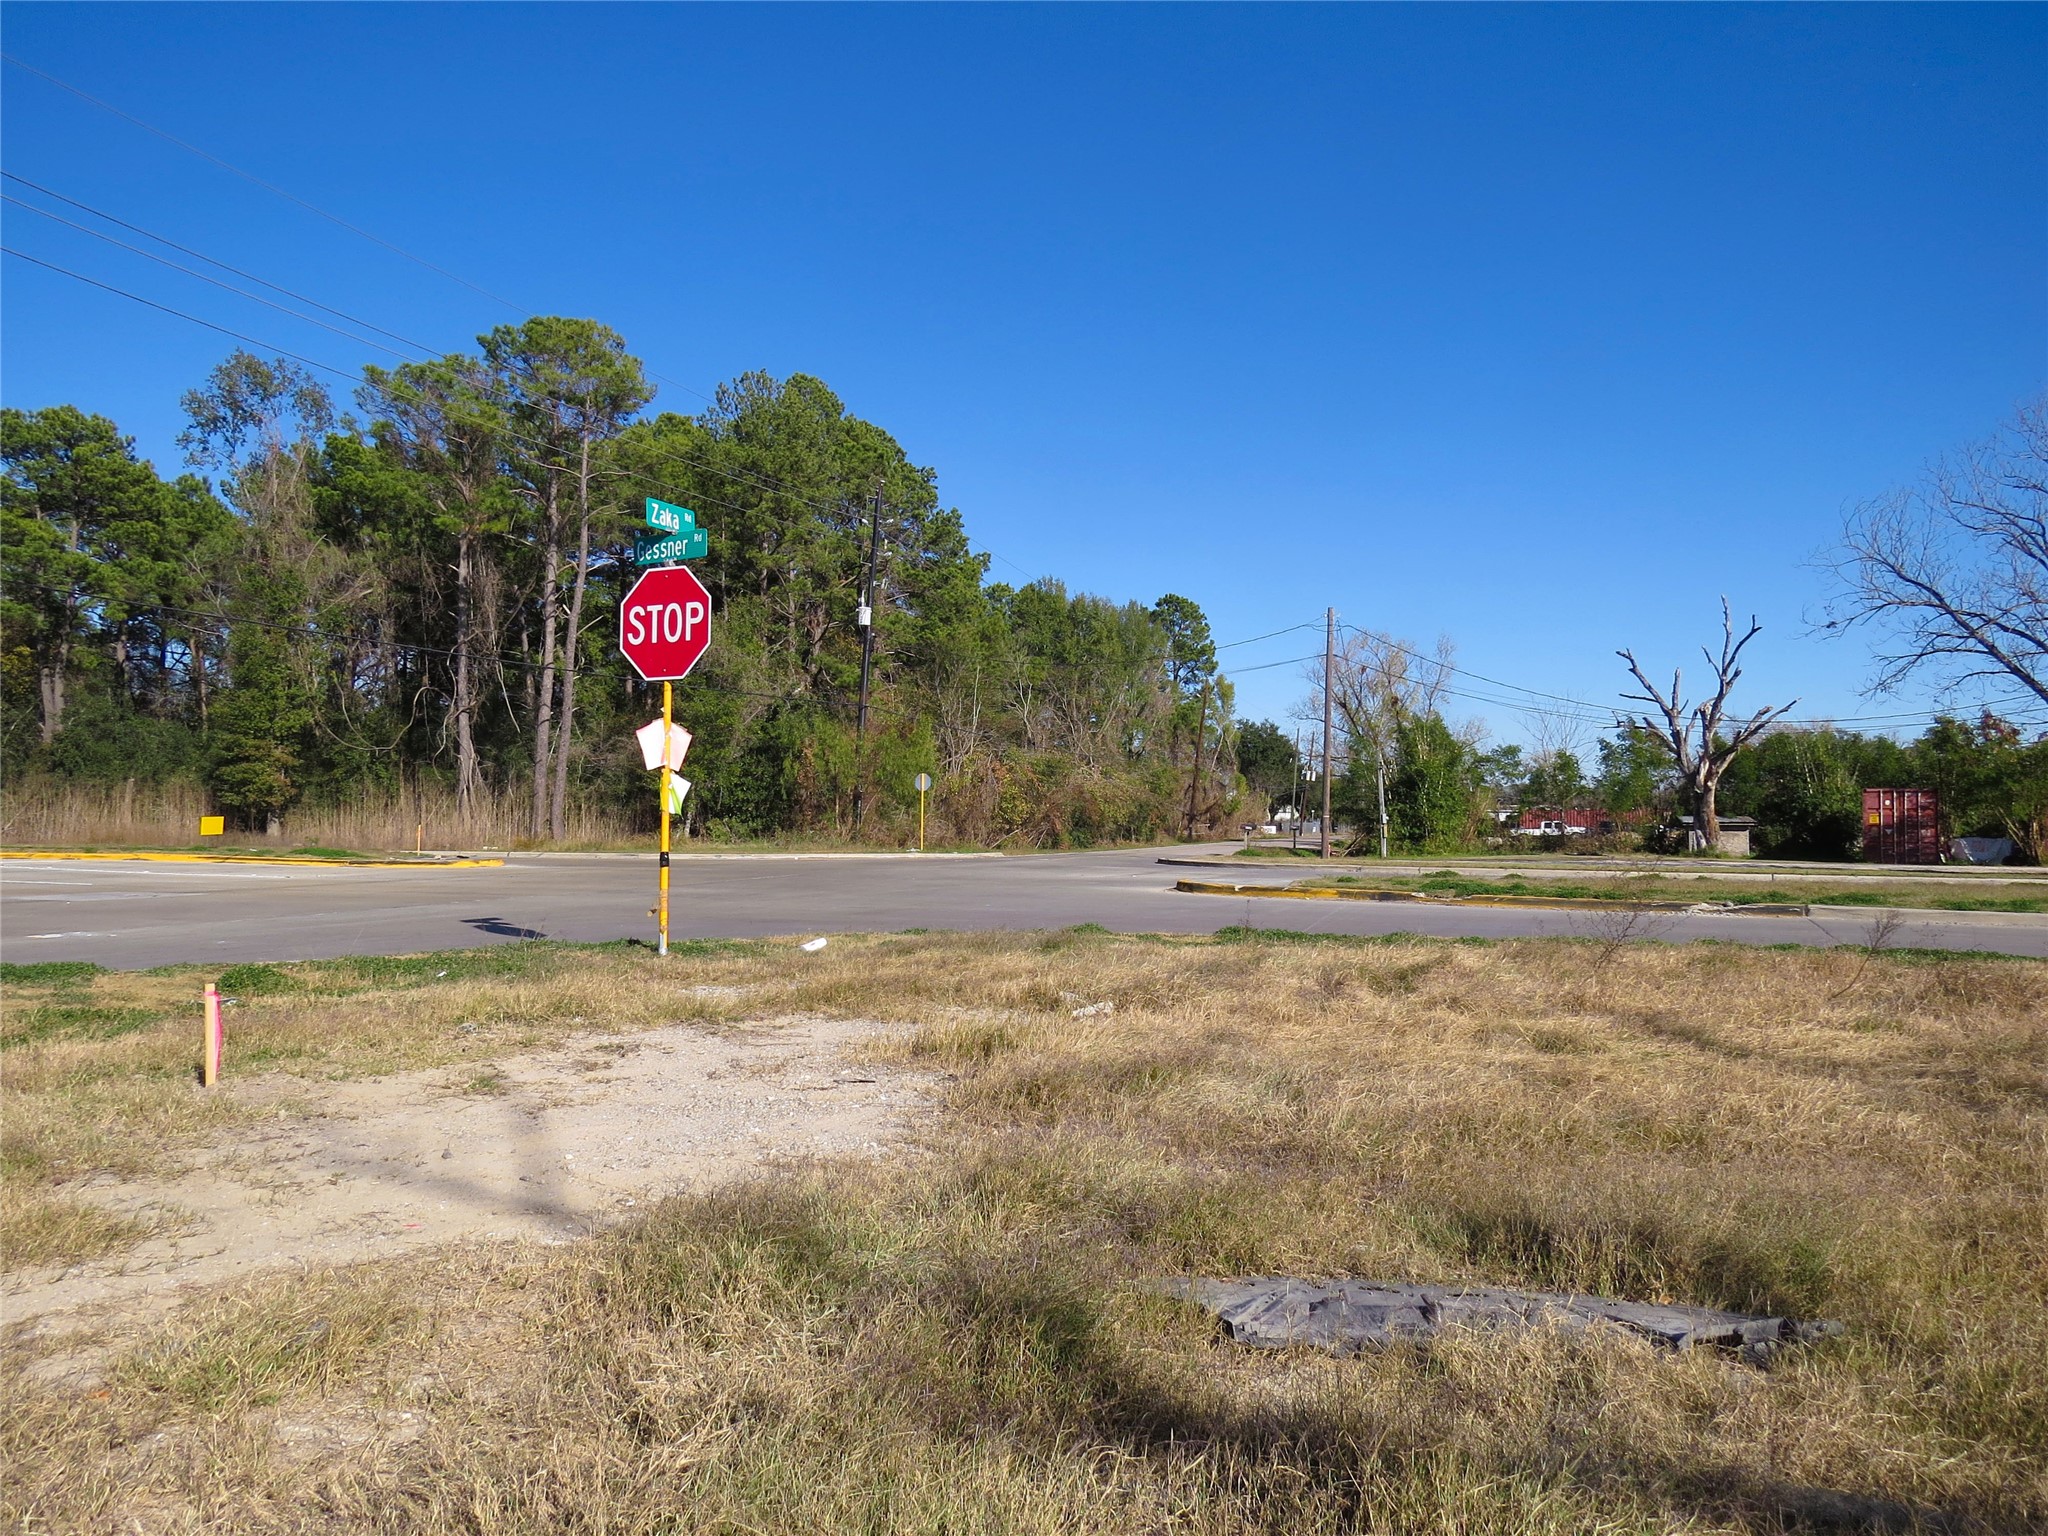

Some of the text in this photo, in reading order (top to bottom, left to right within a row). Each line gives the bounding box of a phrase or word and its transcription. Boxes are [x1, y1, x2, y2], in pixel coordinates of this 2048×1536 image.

[651, 502, 692, 530] Zaka Rd
[637, 533, 702, 561] Gessner Rd
[627, 601, 704, 645] STOP
